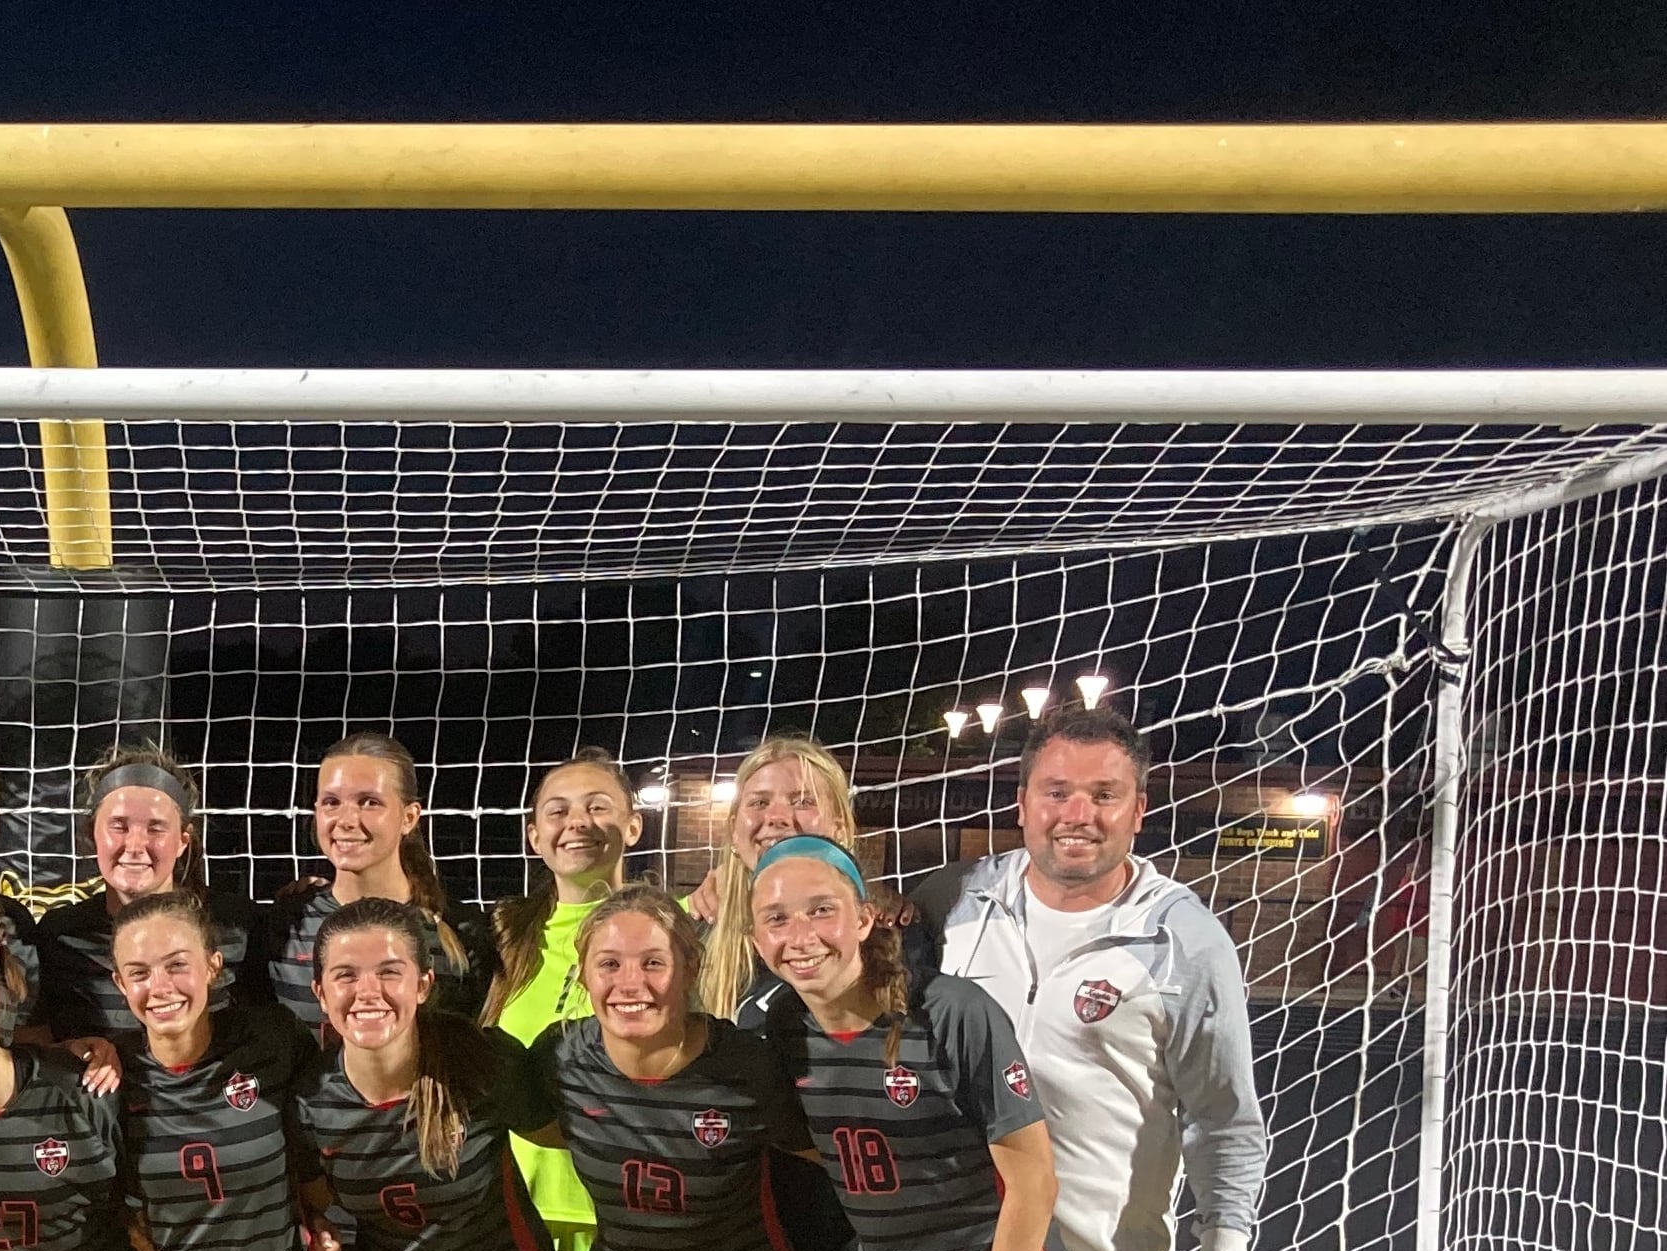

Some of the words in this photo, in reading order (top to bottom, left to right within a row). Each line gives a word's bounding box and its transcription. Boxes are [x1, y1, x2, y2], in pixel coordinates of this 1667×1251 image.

[180, 1142, 225, 1203] 9
[621, 1159, 685, 1213] 13
[833, 1127, 900, 1195] 18
[379, 1183, 425, 1229] 6
